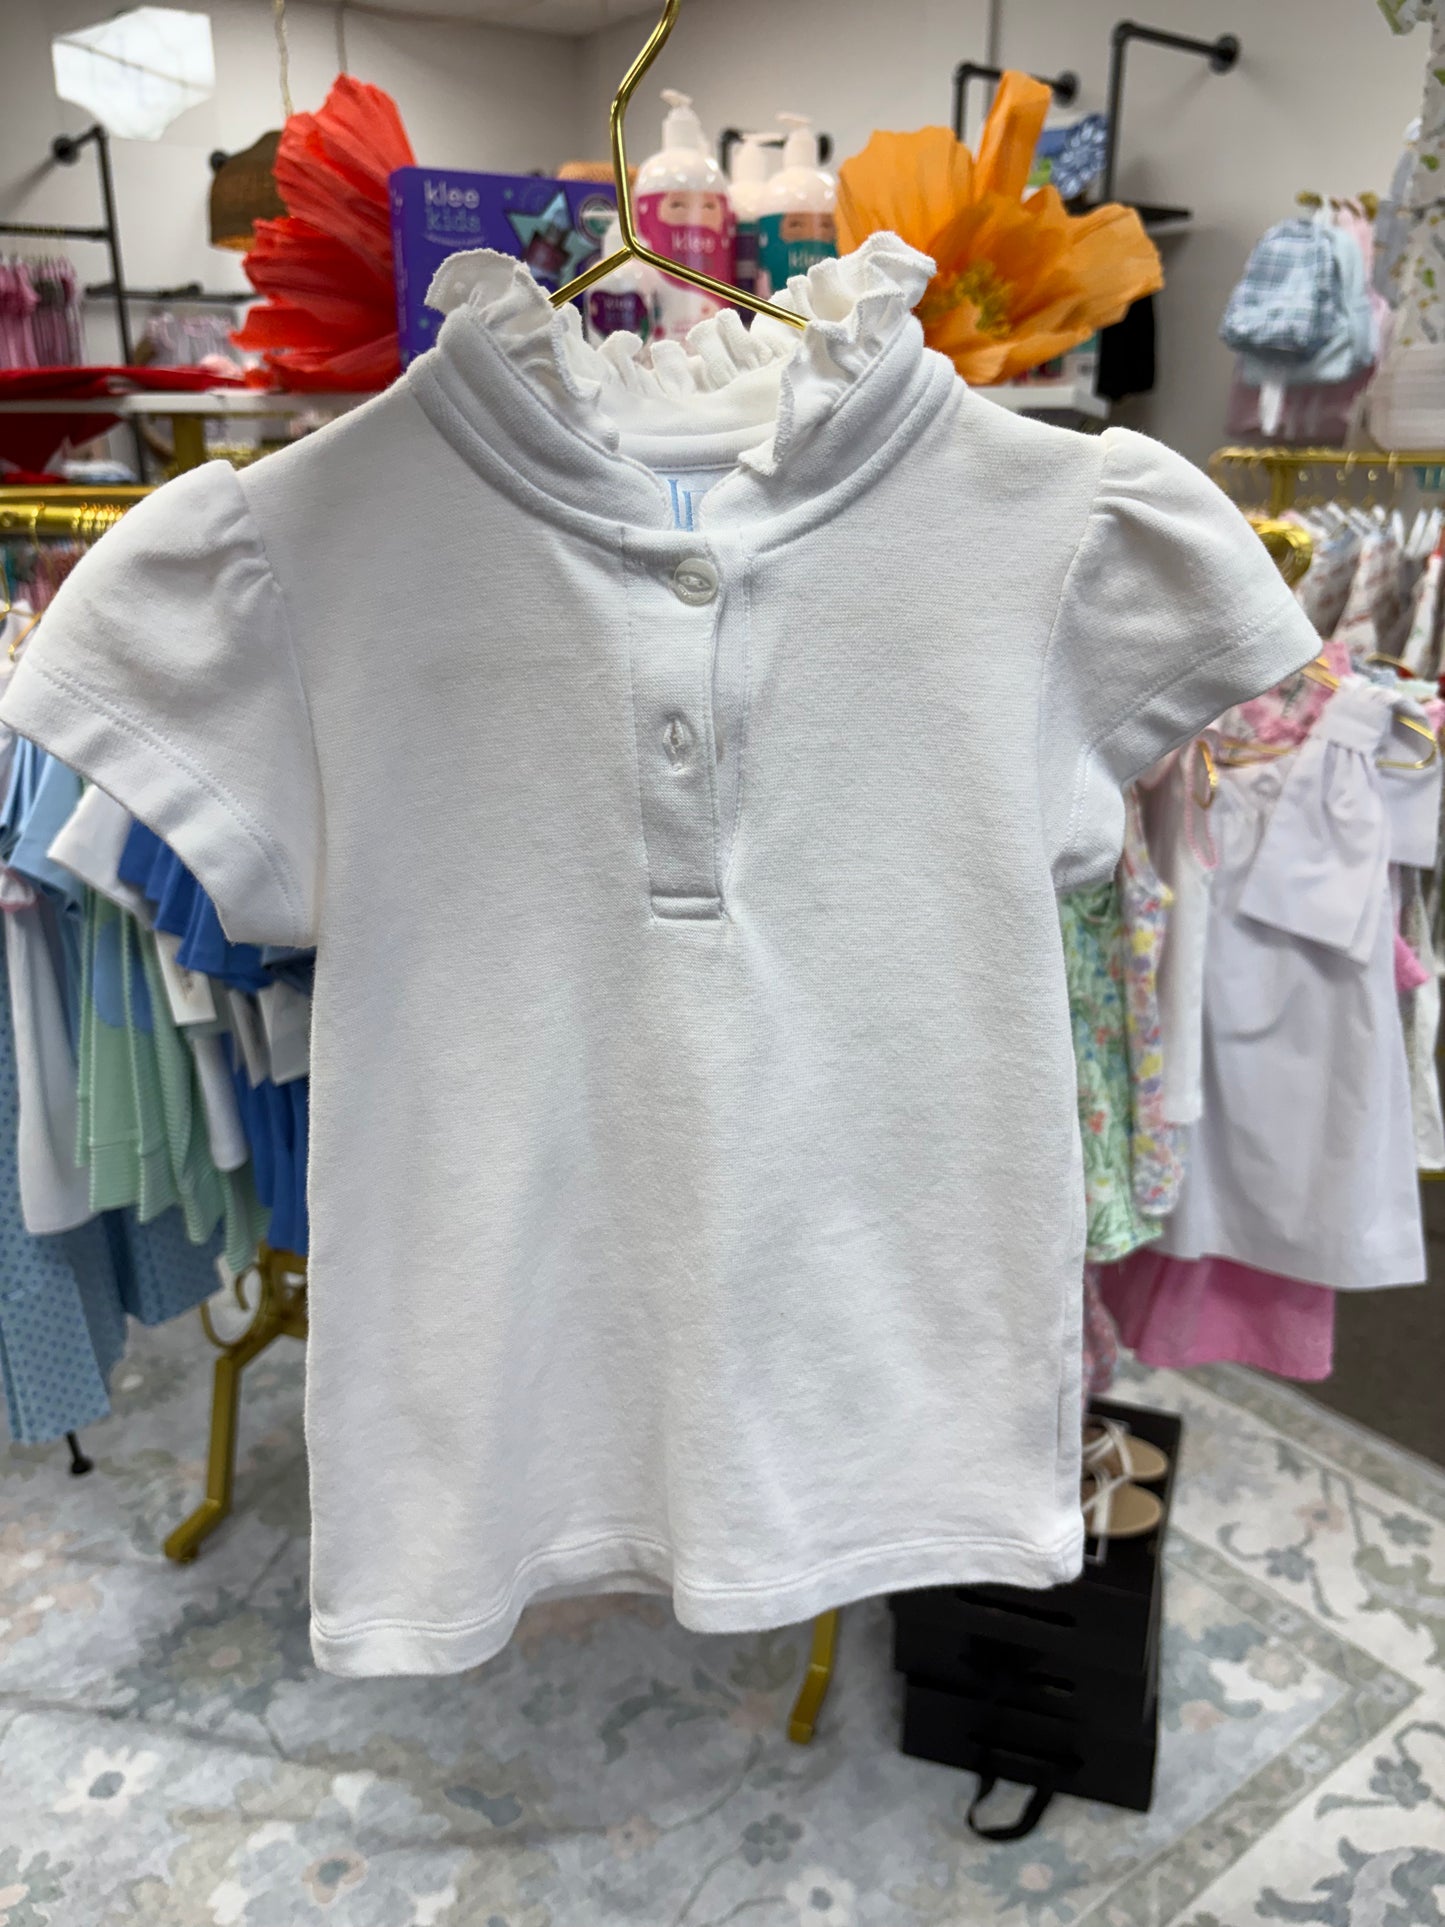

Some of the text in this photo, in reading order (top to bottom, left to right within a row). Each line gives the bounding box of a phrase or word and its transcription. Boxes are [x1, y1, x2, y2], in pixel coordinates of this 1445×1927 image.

[424, 179, 480, 209] klee
[425, 208, 481, 232] kids
[671, 229, 715, 253] klee
